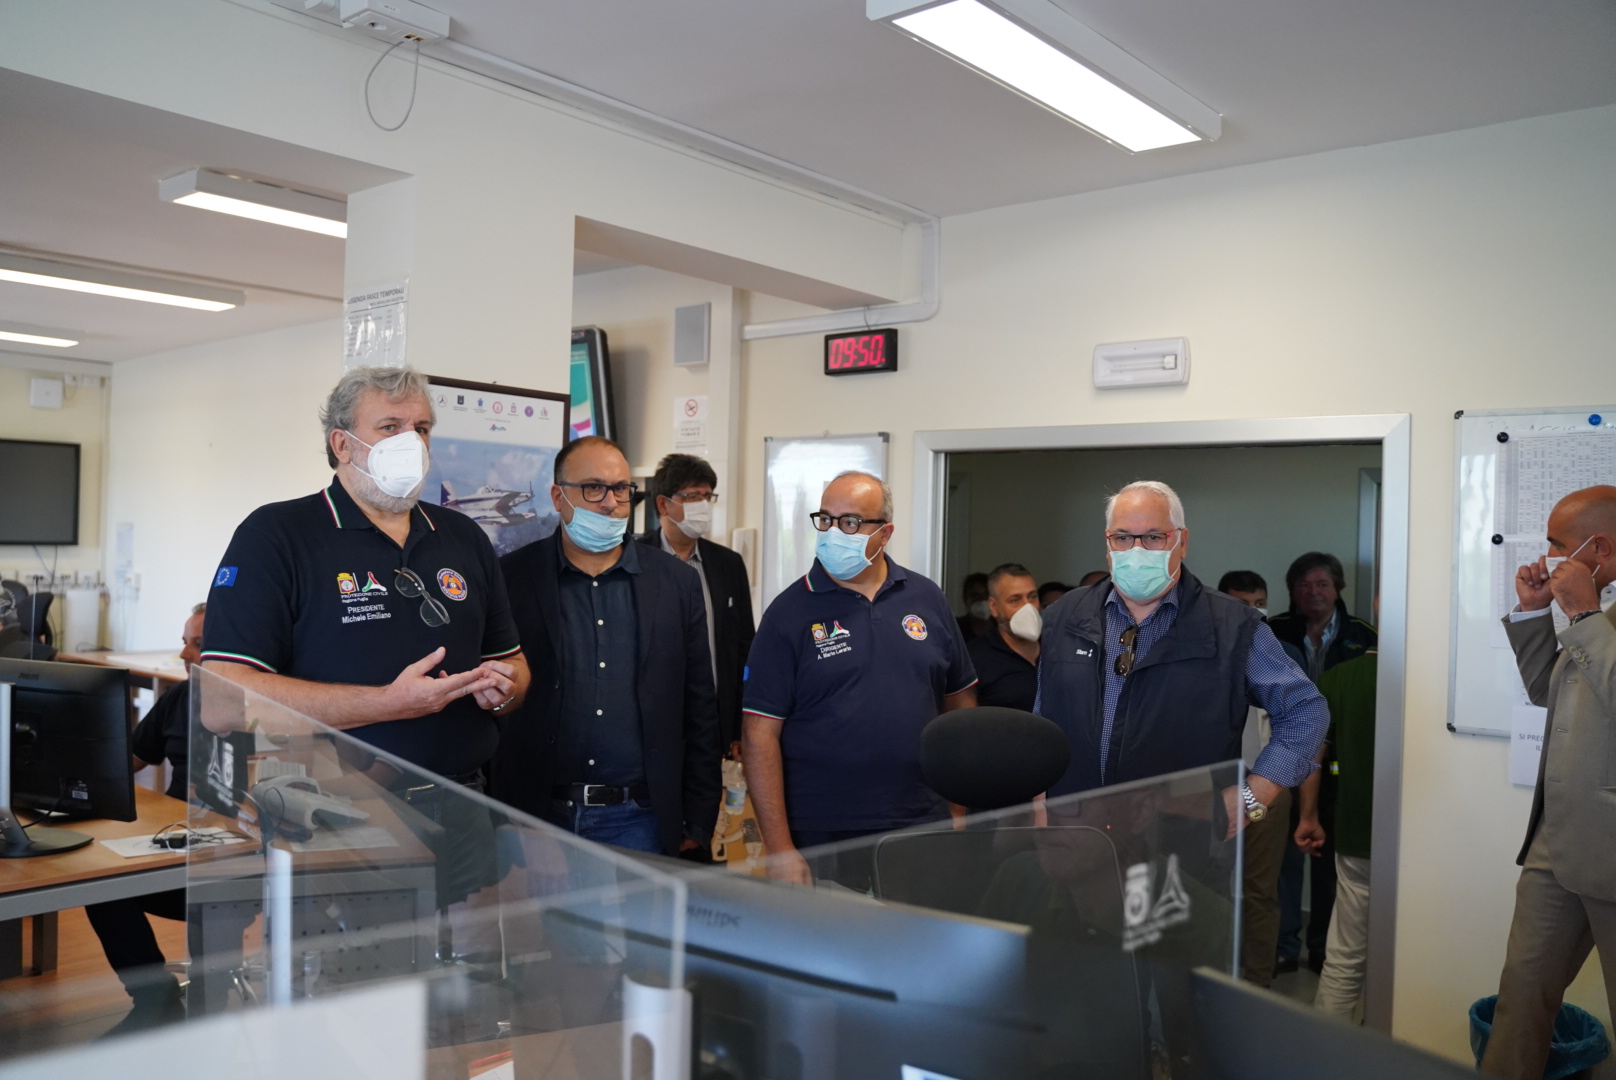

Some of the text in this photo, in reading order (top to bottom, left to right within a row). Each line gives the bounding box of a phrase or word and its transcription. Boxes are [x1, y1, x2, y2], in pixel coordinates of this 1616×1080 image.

[366, 291, 379, 300] FASCE
[347, 604, 385, 614] PRESIDENTE
[341, 612, 391, 624] Michele Emiliano
[1518, 733, 1526, 741] SI
